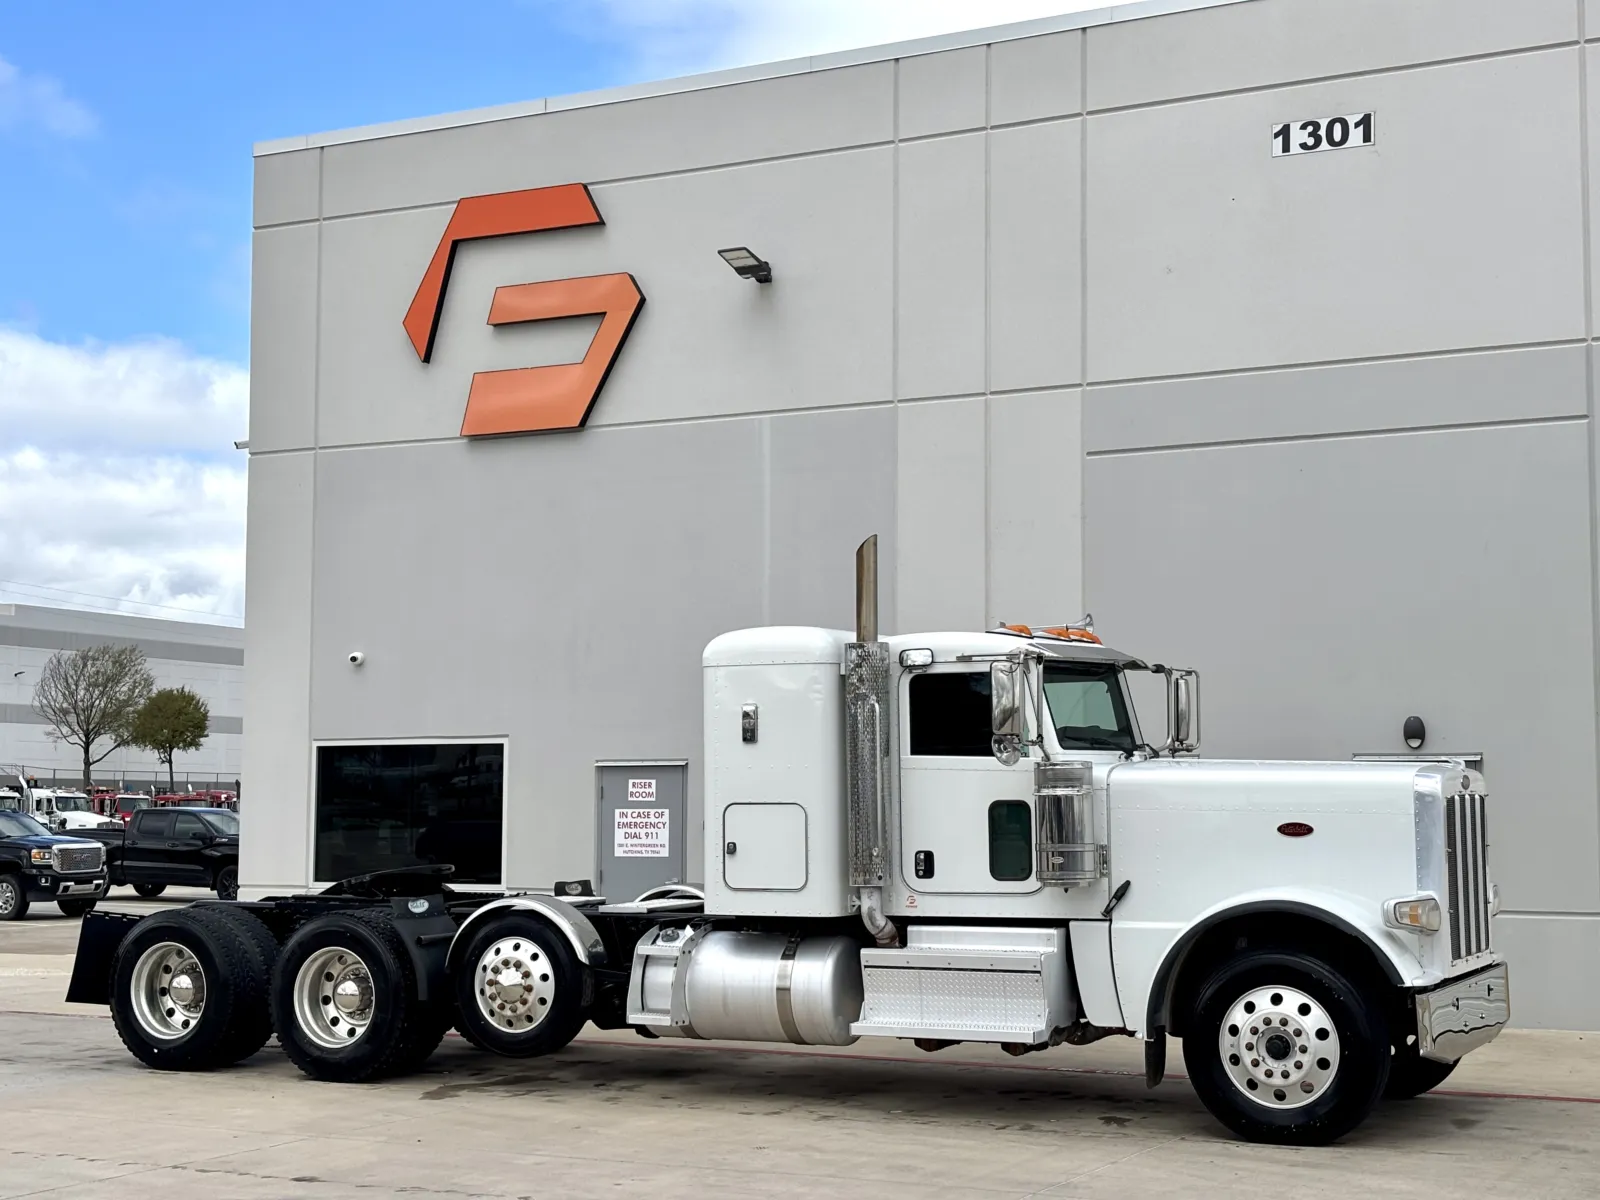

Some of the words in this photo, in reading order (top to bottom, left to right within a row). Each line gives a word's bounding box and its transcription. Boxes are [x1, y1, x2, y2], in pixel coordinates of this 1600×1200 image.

[1273, 112, 1372, 154] 1301
[631, 781, 653, 789] RISER
[629, 791, 655, 799] ROOM
[619, 811, 628, 819] IN
[630, 811, 651, 819] CASE
[653, 811, 666, 819] OF
[617, 821, 667, 829] EMERGENCY
[624, 831, 642, 840] DIAL
[644, 831, 659, 840] 911
